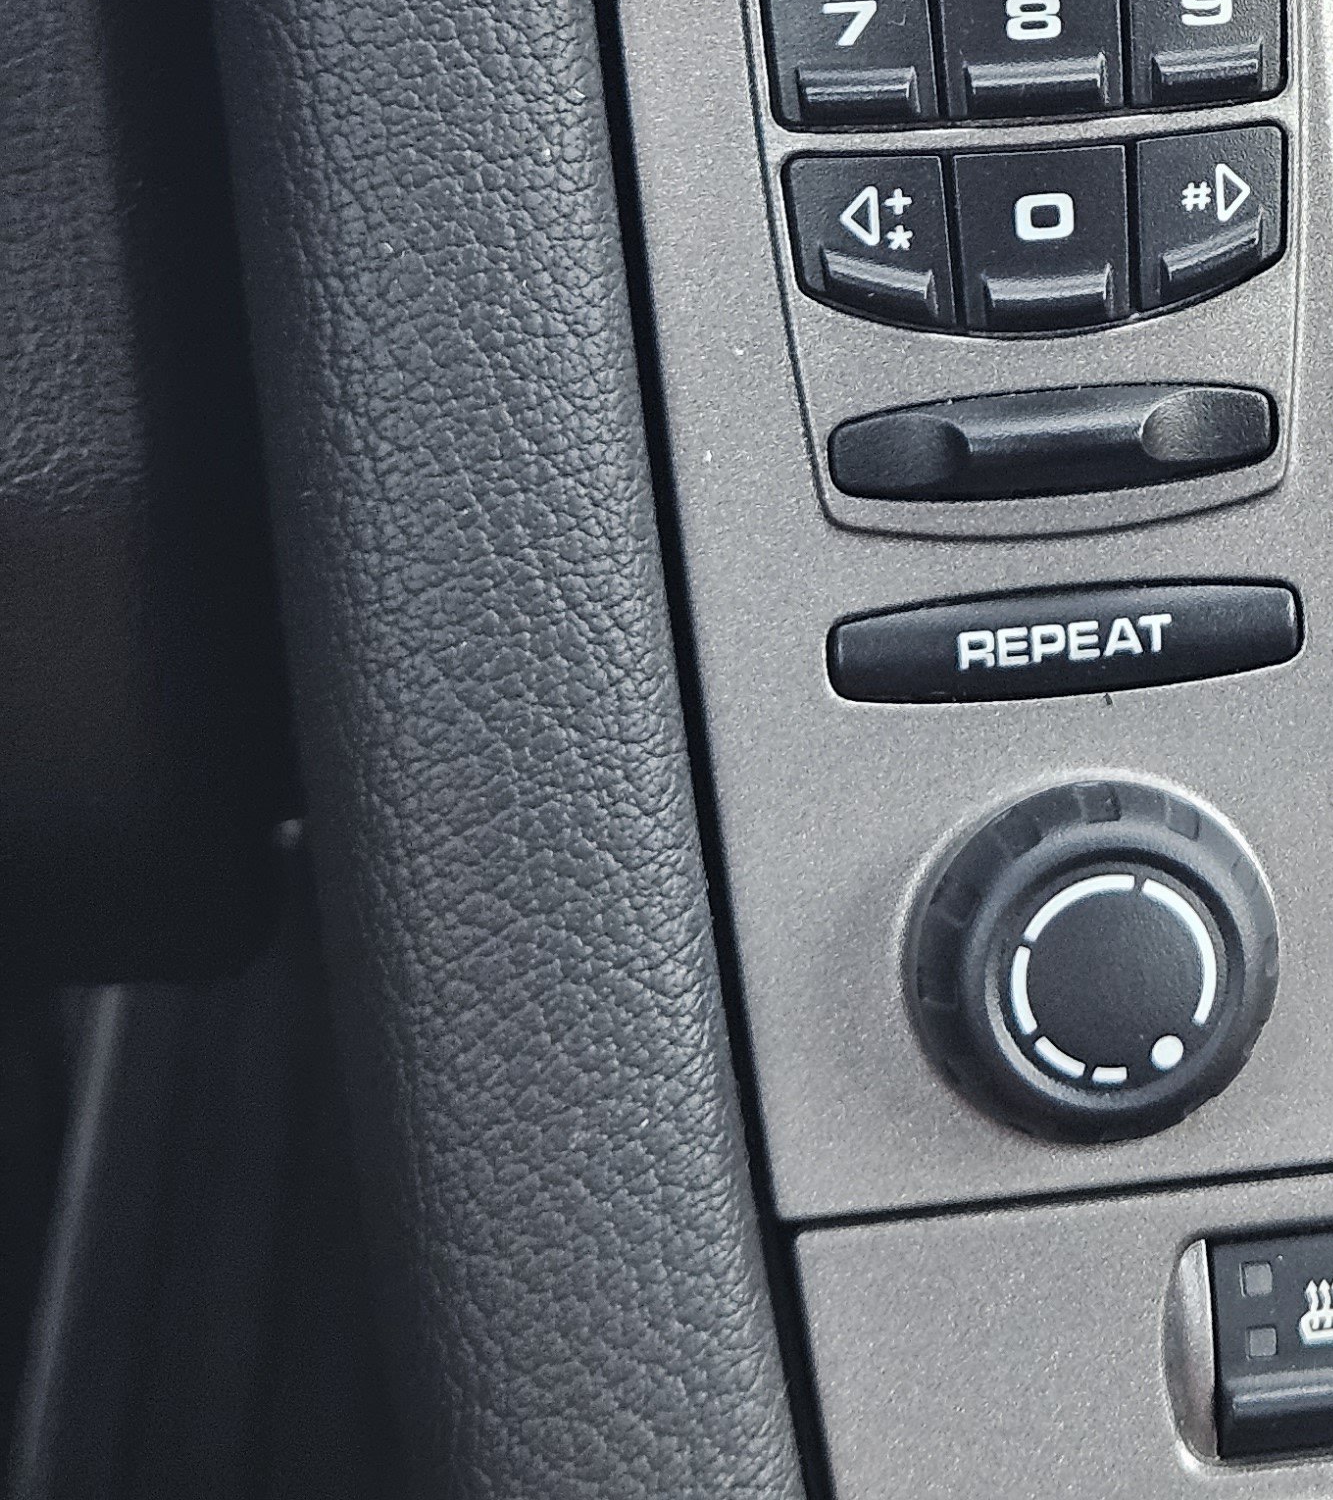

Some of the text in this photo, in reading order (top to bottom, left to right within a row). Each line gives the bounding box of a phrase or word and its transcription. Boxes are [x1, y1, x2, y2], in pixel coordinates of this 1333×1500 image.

[822, 0, 878, 47] 7
[1014, 191, 1075, 241] 0
[956, 613, 1172, 670] REPEAT
